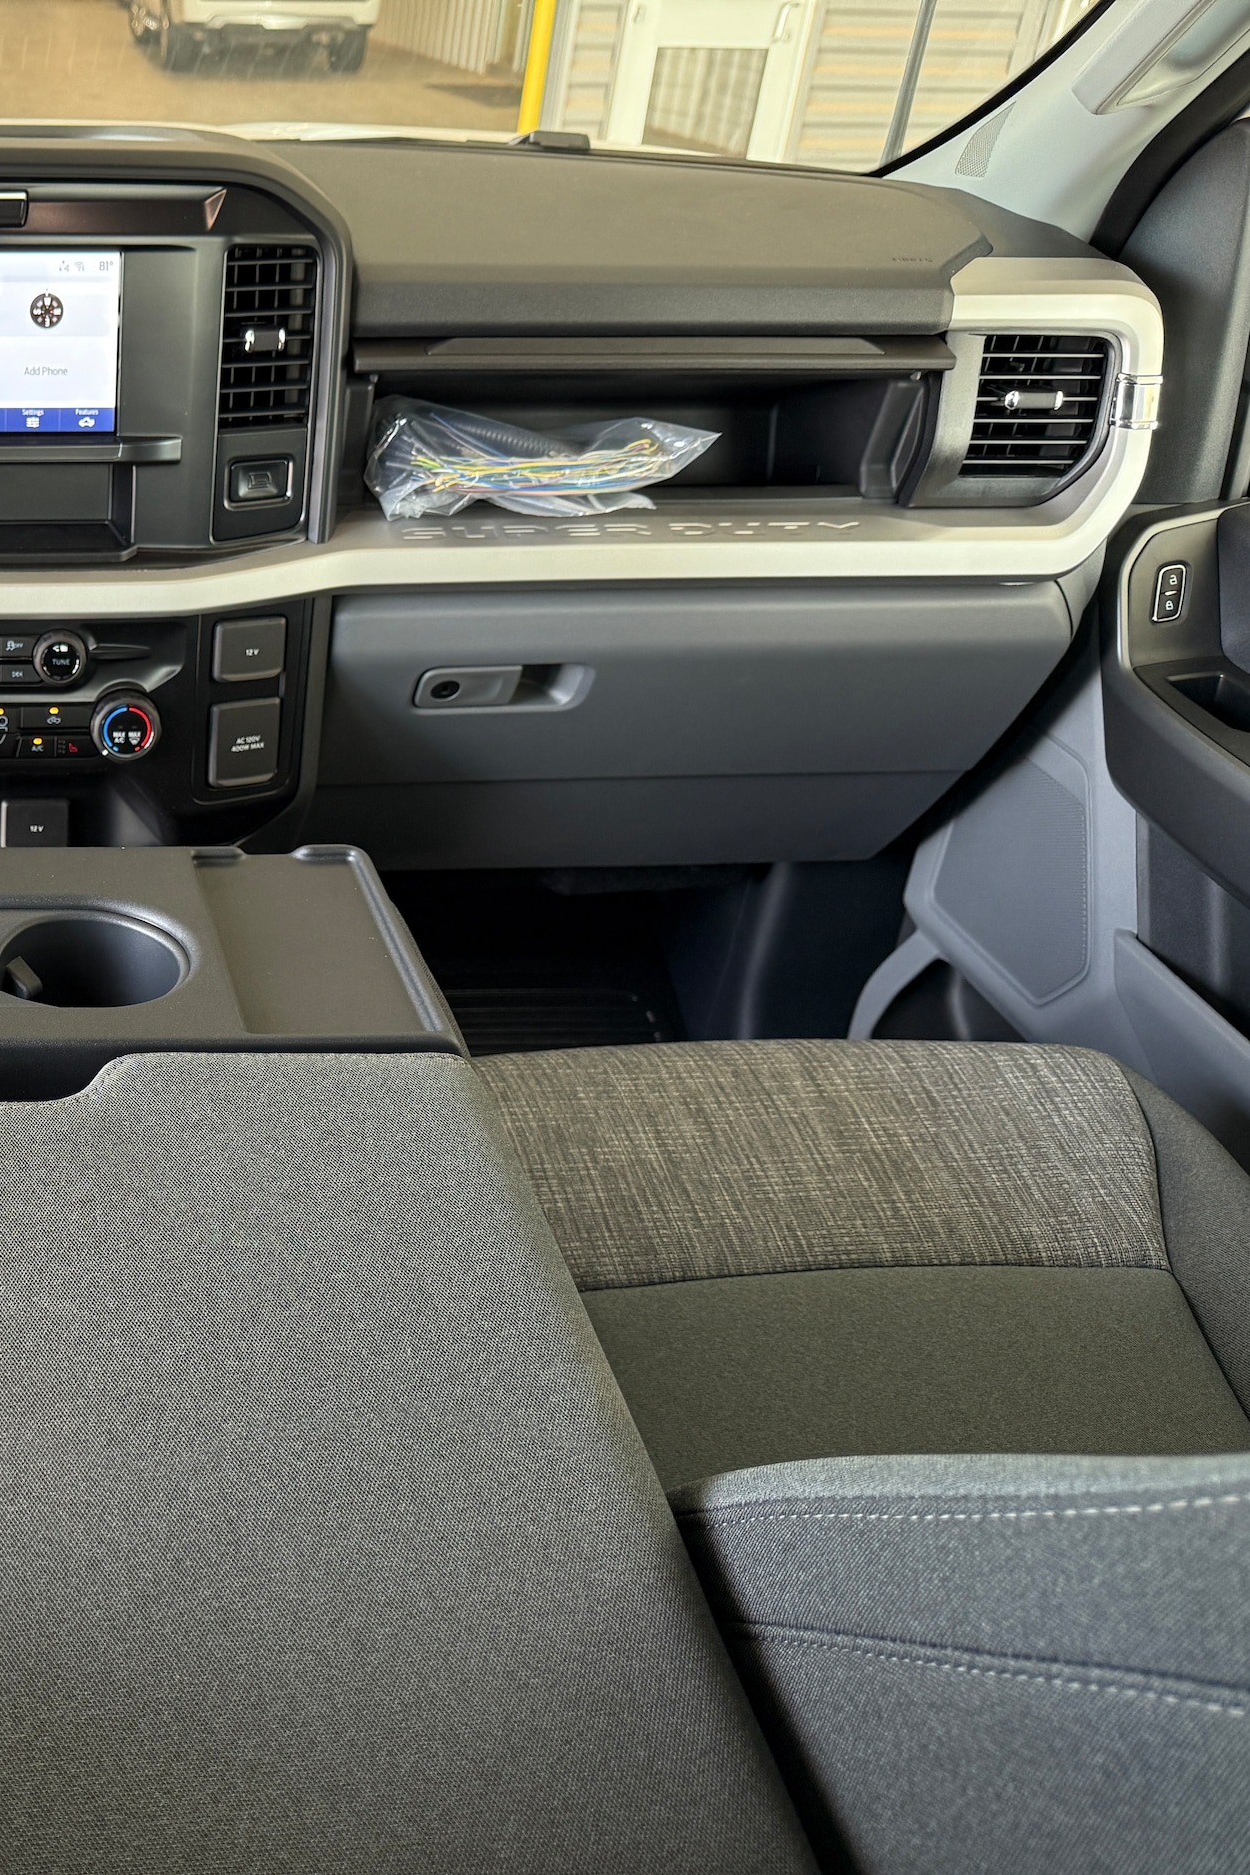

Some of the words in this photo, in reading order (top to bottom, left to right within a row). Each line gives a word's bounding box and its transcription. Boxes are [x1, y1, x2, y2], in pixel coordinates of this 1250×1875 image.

[99, 260, 114, 271] 81°
[24, 366, 41, 376] Add
[42, 366, 68, 376] Phone
[236, 735, 246, 745] AC
[31, 744, 44, 752] A/C
[250, 741, 265, 750] MAX
